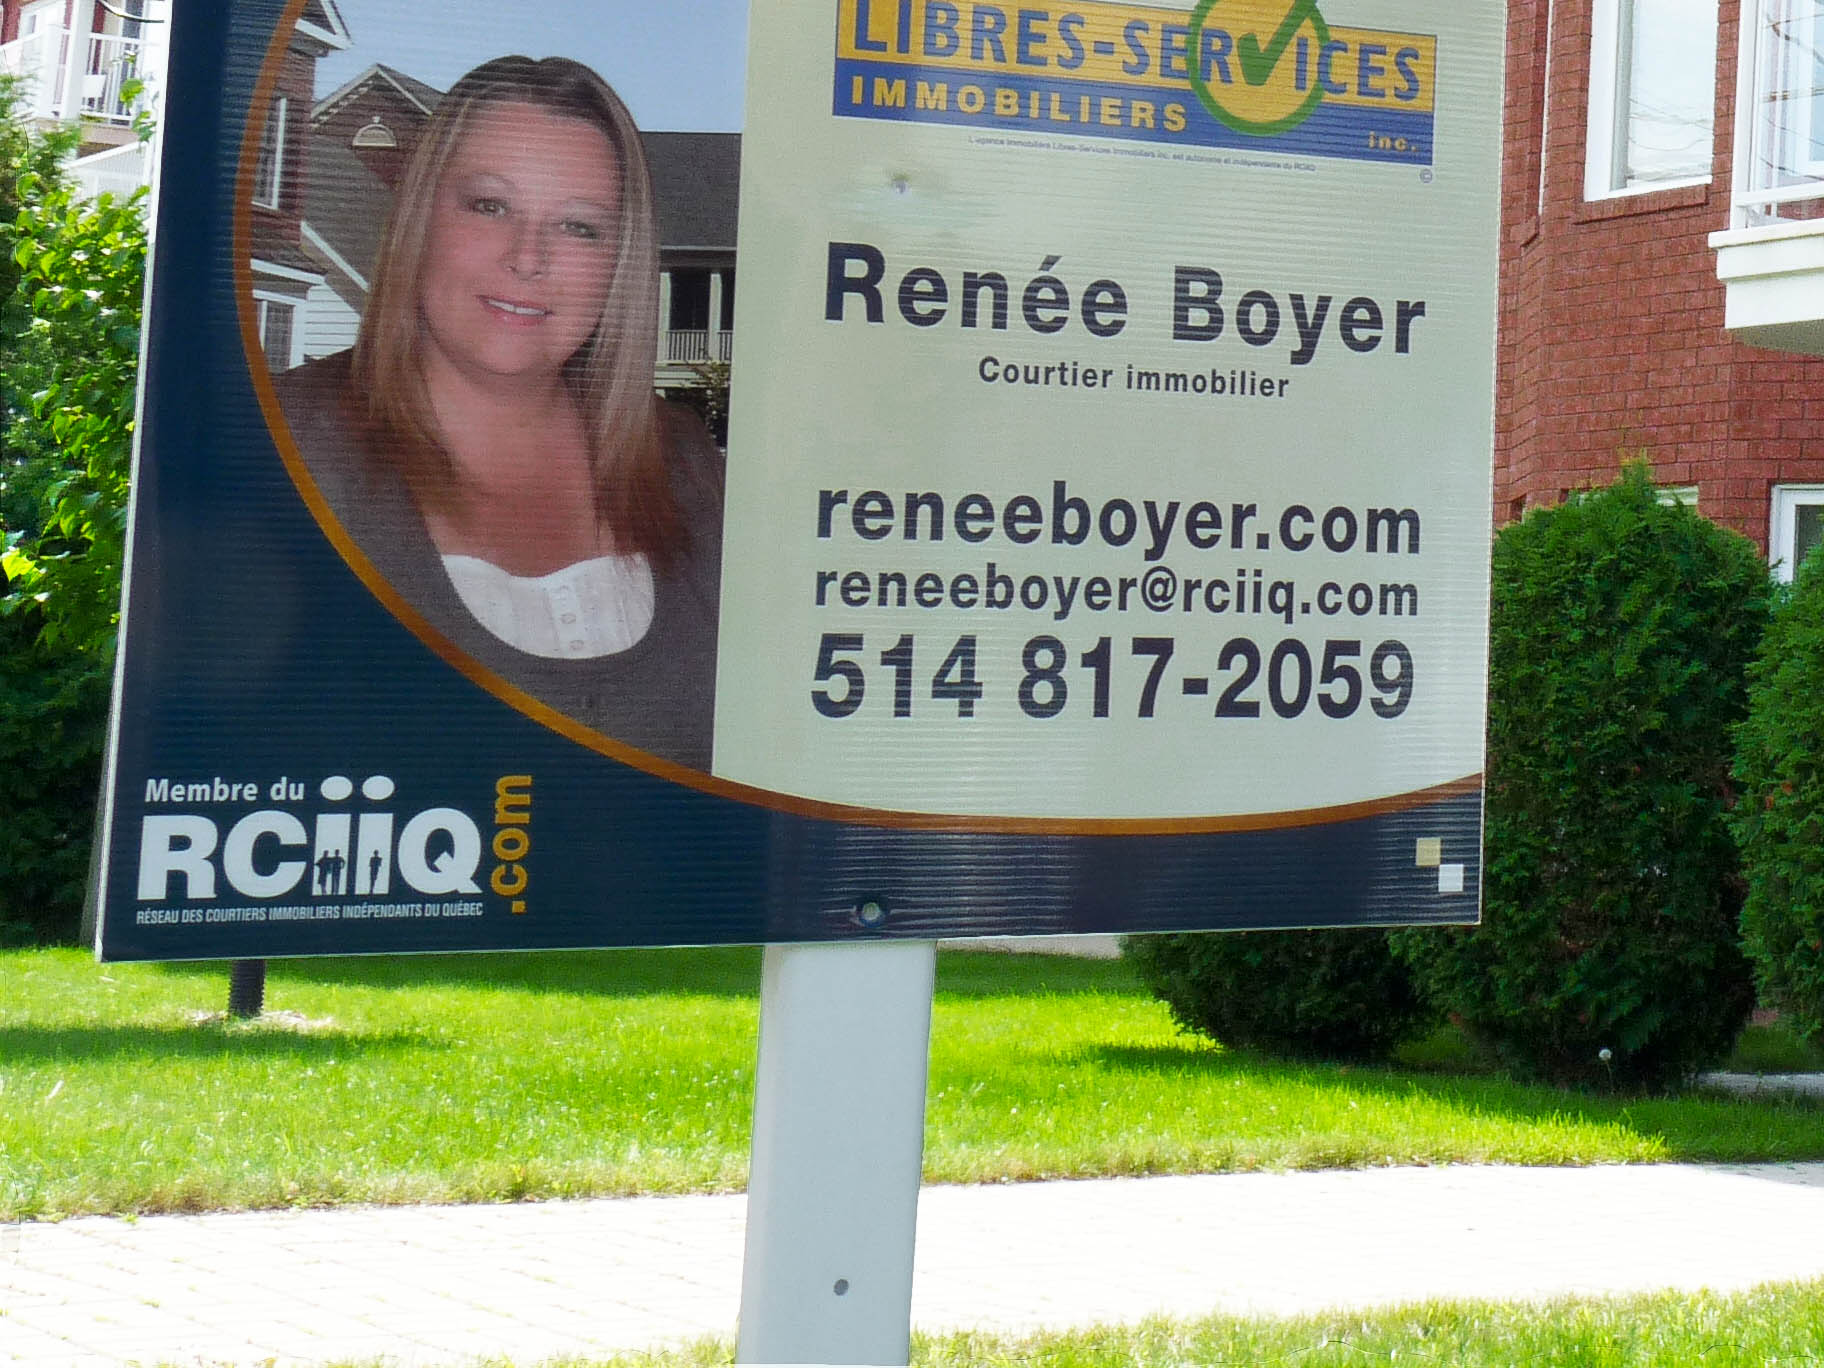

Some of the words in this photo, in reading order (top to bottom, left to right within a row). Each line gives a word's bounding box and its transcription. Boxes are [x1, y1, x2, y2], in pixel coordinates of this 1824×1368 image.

[851, 75, 1187, 132] IMMOBILIERS
[1368, 130, 1417, 151] inc.
[823, 241, 1130, 338] Renée
[1172, 265, 1426, 366] Boyer
[978, 356, 1114, 388] Courtier
[1127, 364, 1290, 398] immobilier
[815, 480, 1422, 561] reneeboyer.com
[815, 563, 1419, 624] reneeboyer@rciiq.com
[811, 633, 983, 719] 514
[1017, 635, 1415, 720] 817-2059
[145, 778, 258, 803] Membre
[269, 776, 306, 801] du
[136, 907, 180, 925] RÉSEAU
[181, 909, 204, 923] DES
[205, 907, 267, 922] COURTIERS
[268, 904, 340, 921] IMMOBILIERS
[342, 902, 423, 919] INDÉPENDANTS
[424, 903, 440, 917] DU
[442, 900, 484, 917] QUÉBEC
